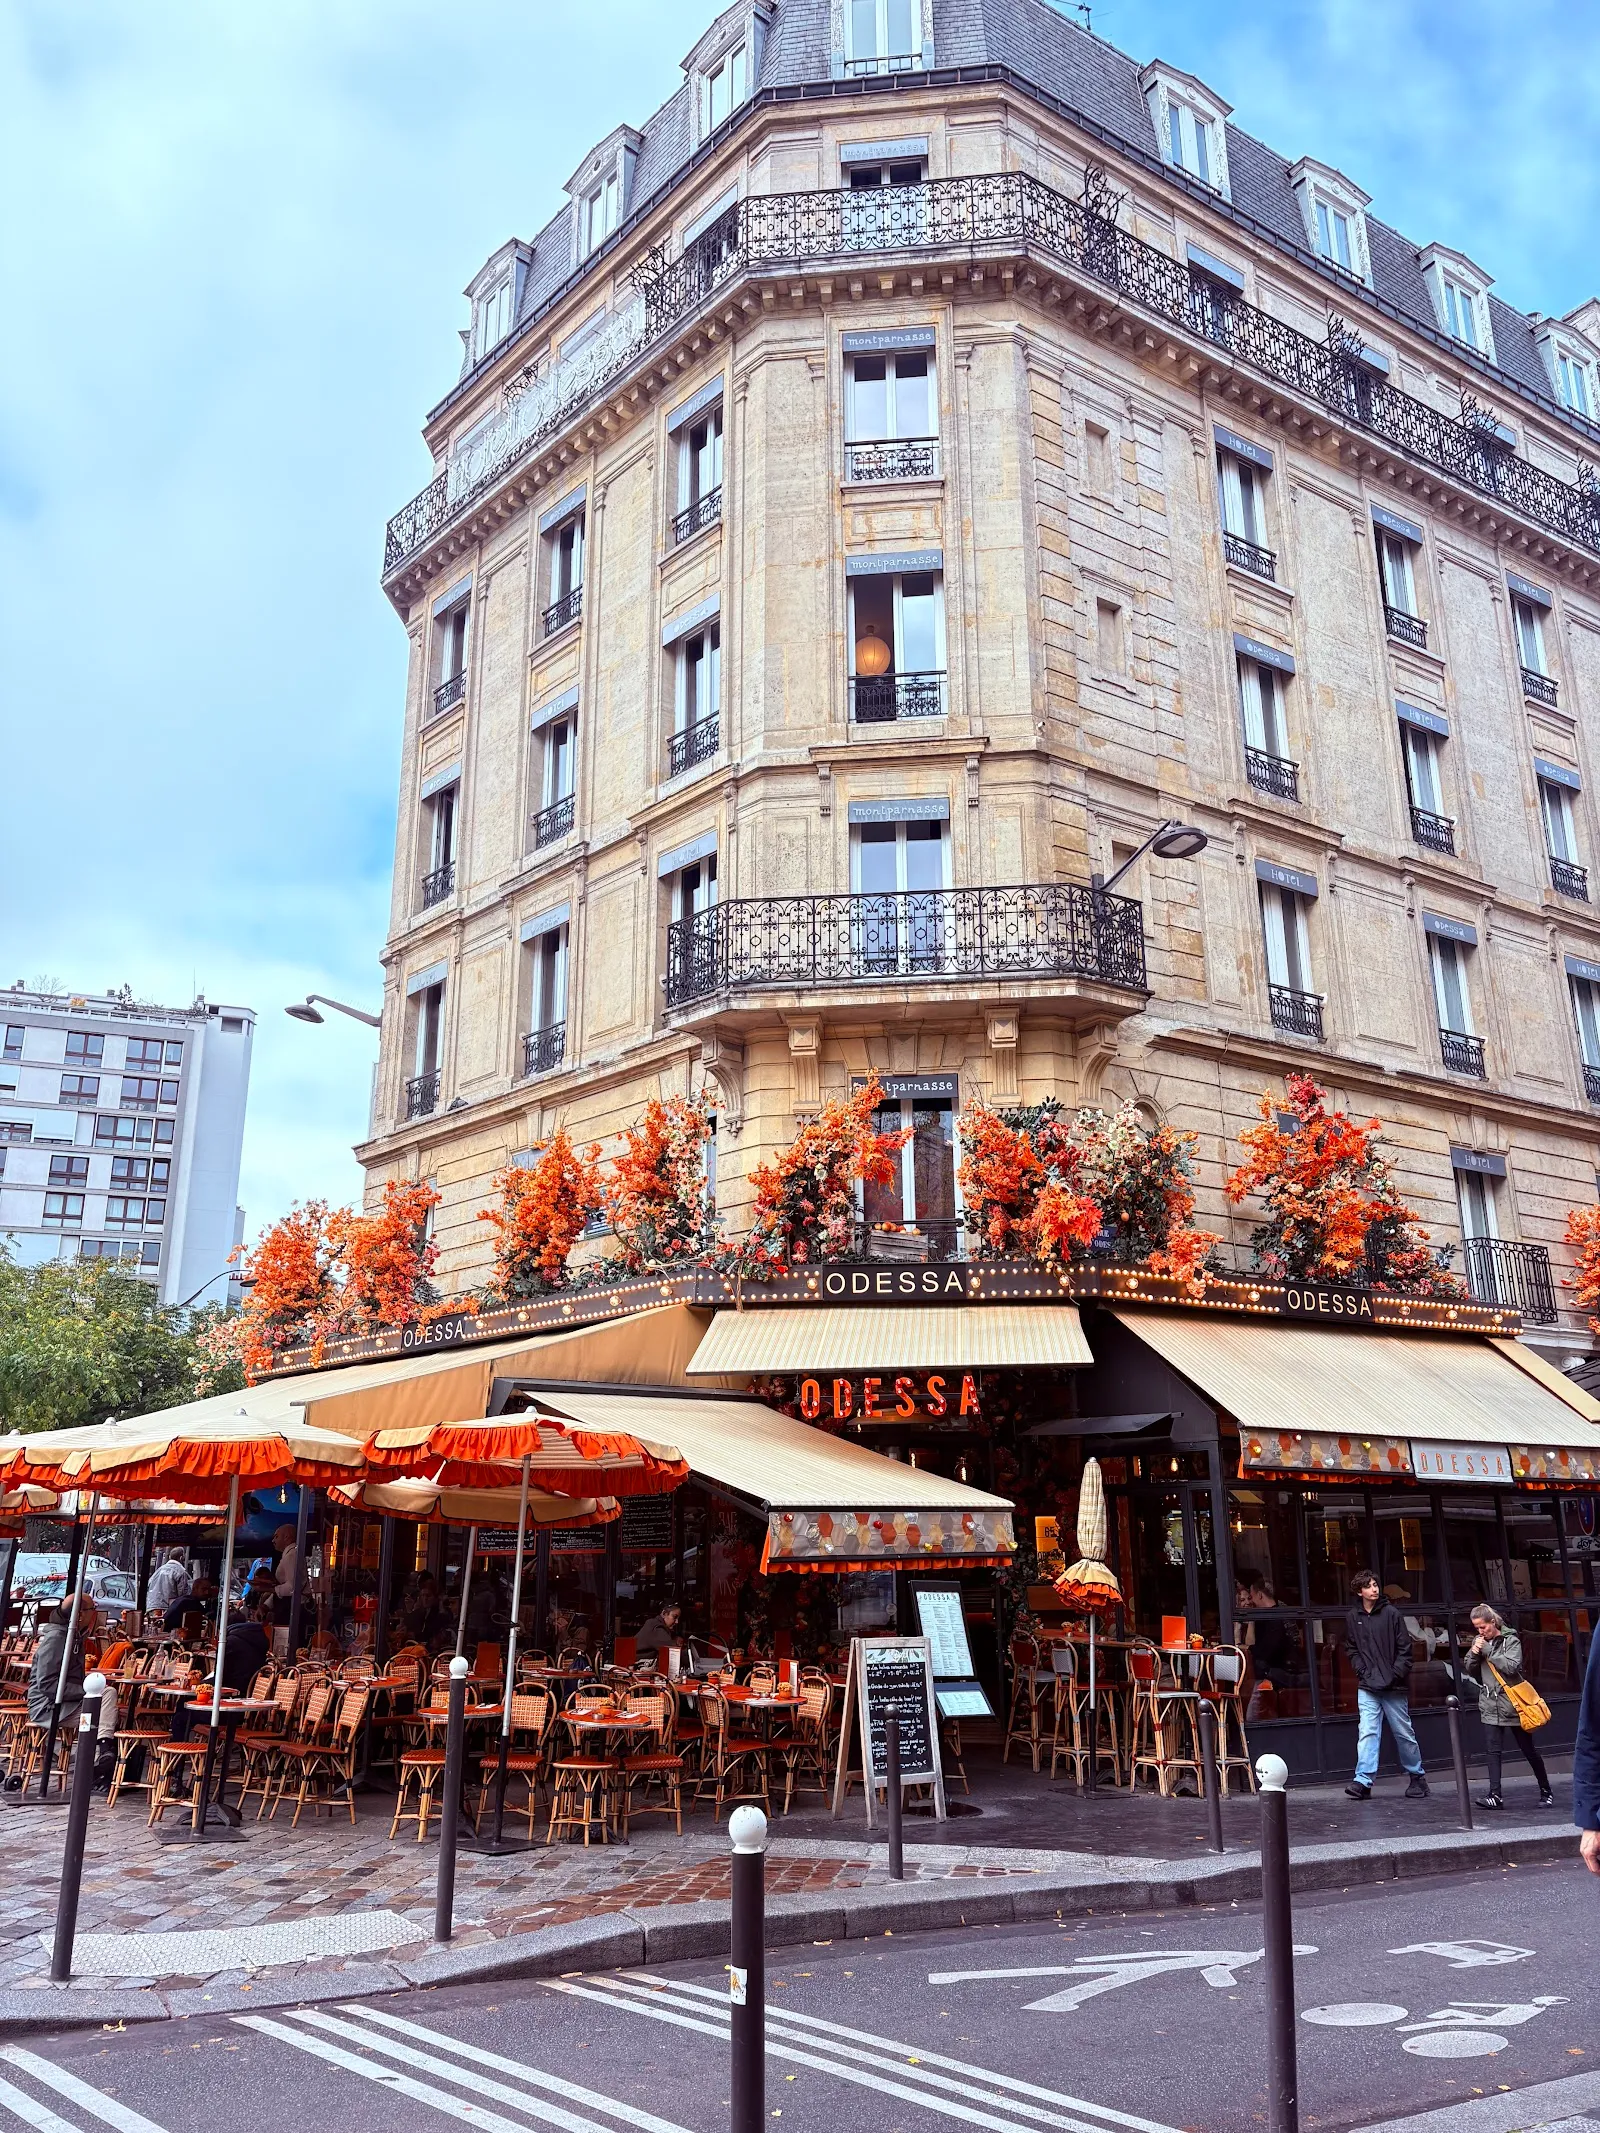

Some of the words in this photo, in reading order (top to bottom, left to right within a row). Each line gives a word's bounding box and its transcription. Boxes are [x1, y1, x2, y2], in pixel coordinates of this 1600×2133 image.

[847, 333, 931, 348] montparnasse
[851, 555, 939, 572] montparnasse
[853, 805, 945, 821] montparnasse
[826, 1270, 964, 1294] ODESSA
[1287, 1288, 1372, 1317] ODESSA
[403, 1318, 465, 1349] ODESSA
[800, 1374, 982, 1420] ODESSA
[1420, 1450, 1507, 1477] ODESSA
